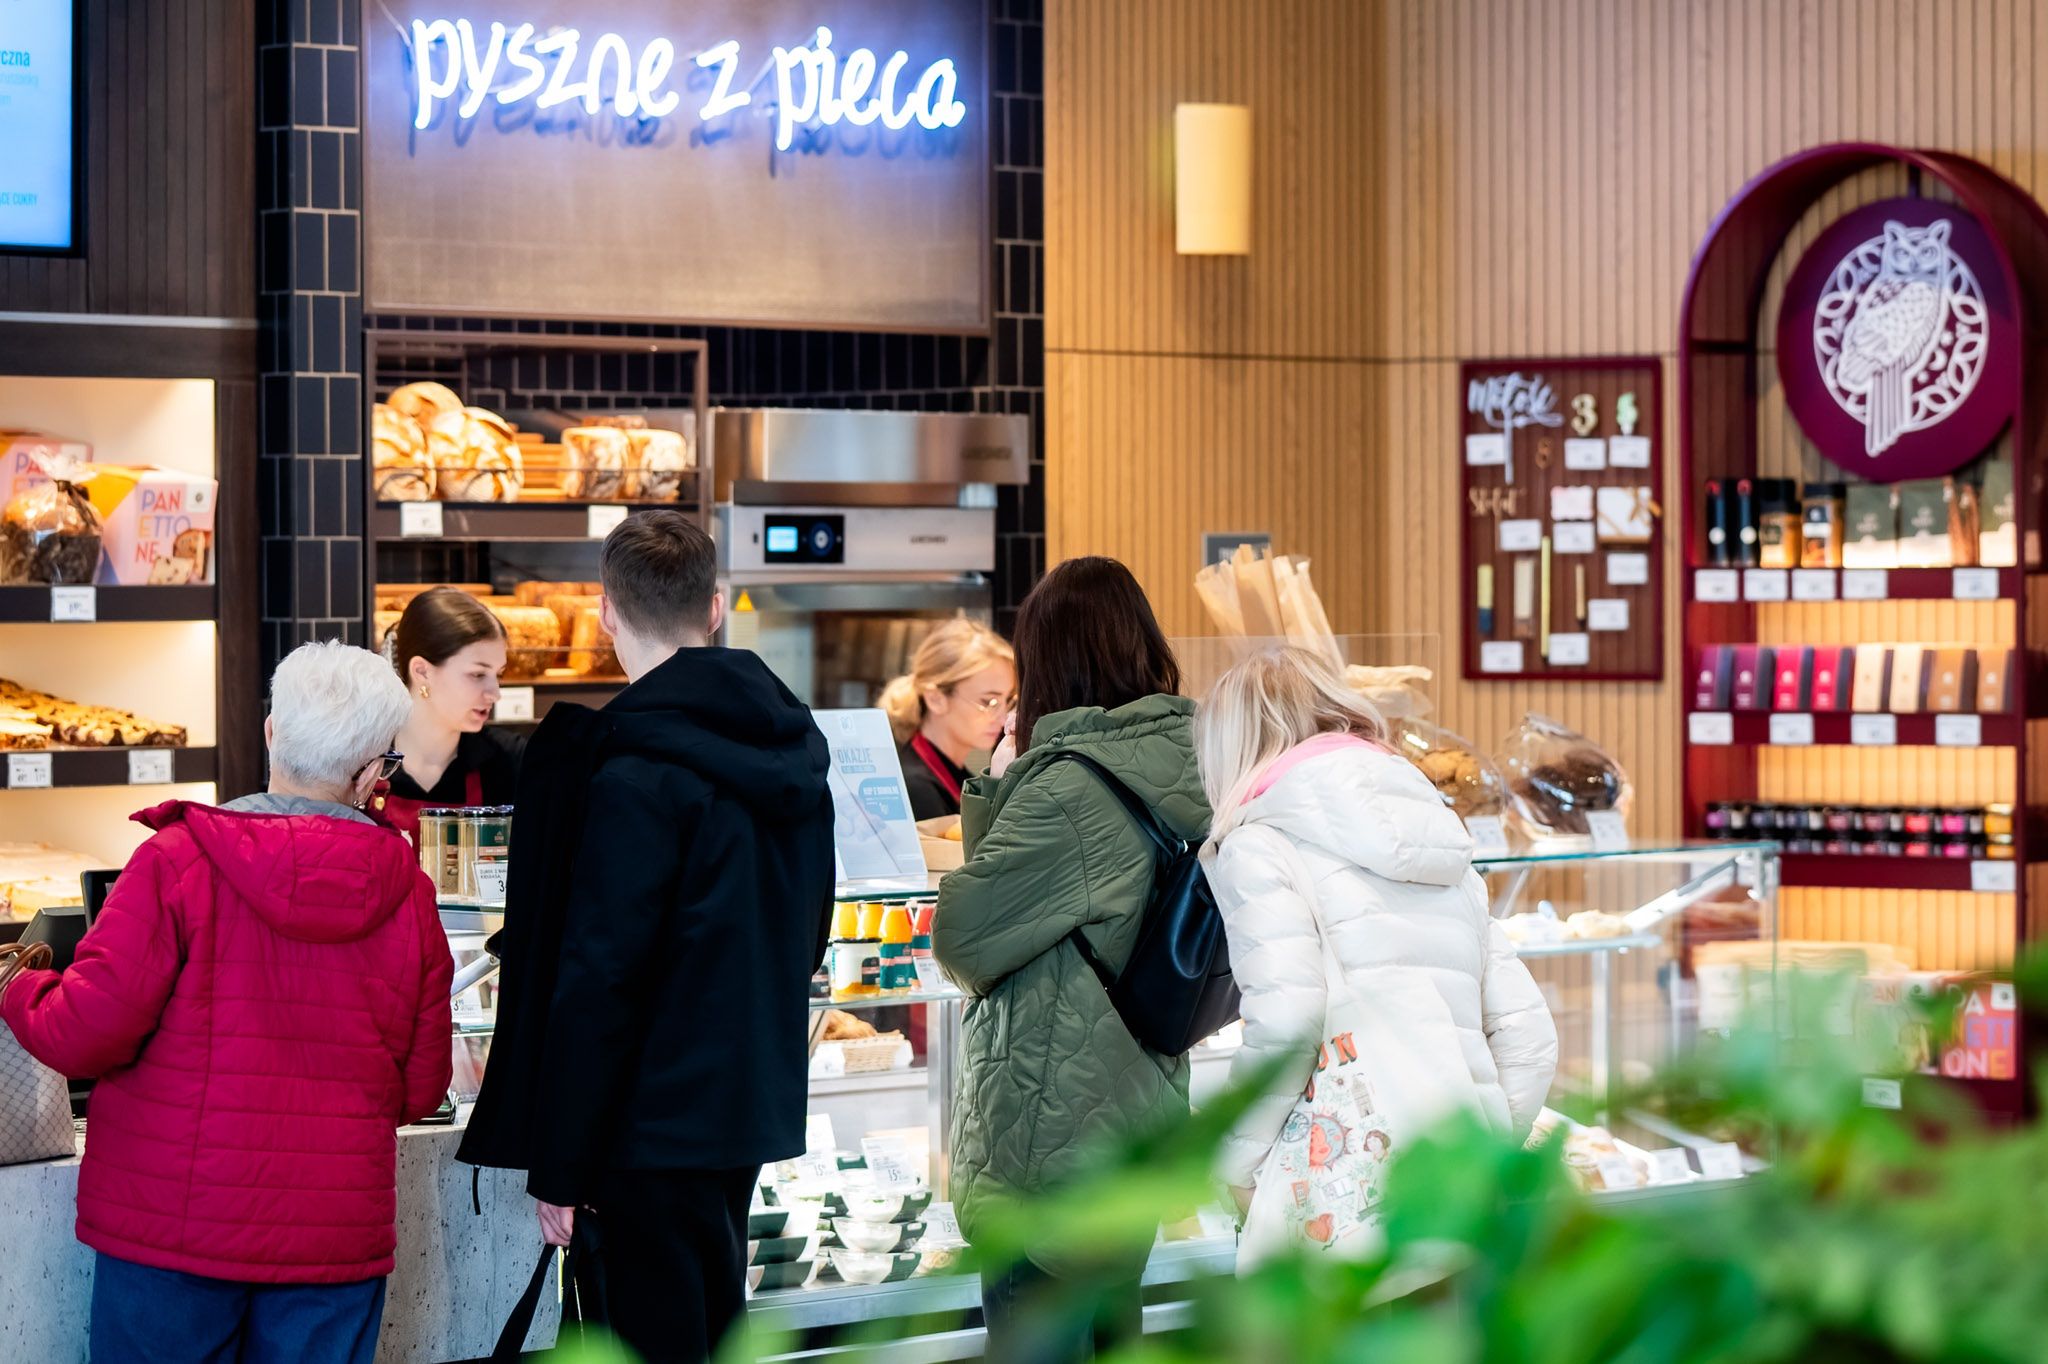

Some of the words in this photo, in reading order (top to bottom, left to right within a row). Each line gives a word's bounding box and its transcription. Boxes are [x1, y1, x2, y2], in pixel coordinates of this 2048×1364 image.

[412, 18, 679, 130] pyszne
[697, 40, 751, 120] z
[773, 26, 966, 151] pieca
[15, 452, 48, 474] PA
[140, 489, 182, 513] PAN
[138, 515, 192, 540] ETTO
[837, 747, 873, 764] OKAZJE
[1944, 1048, 2008, 1079] ONE
